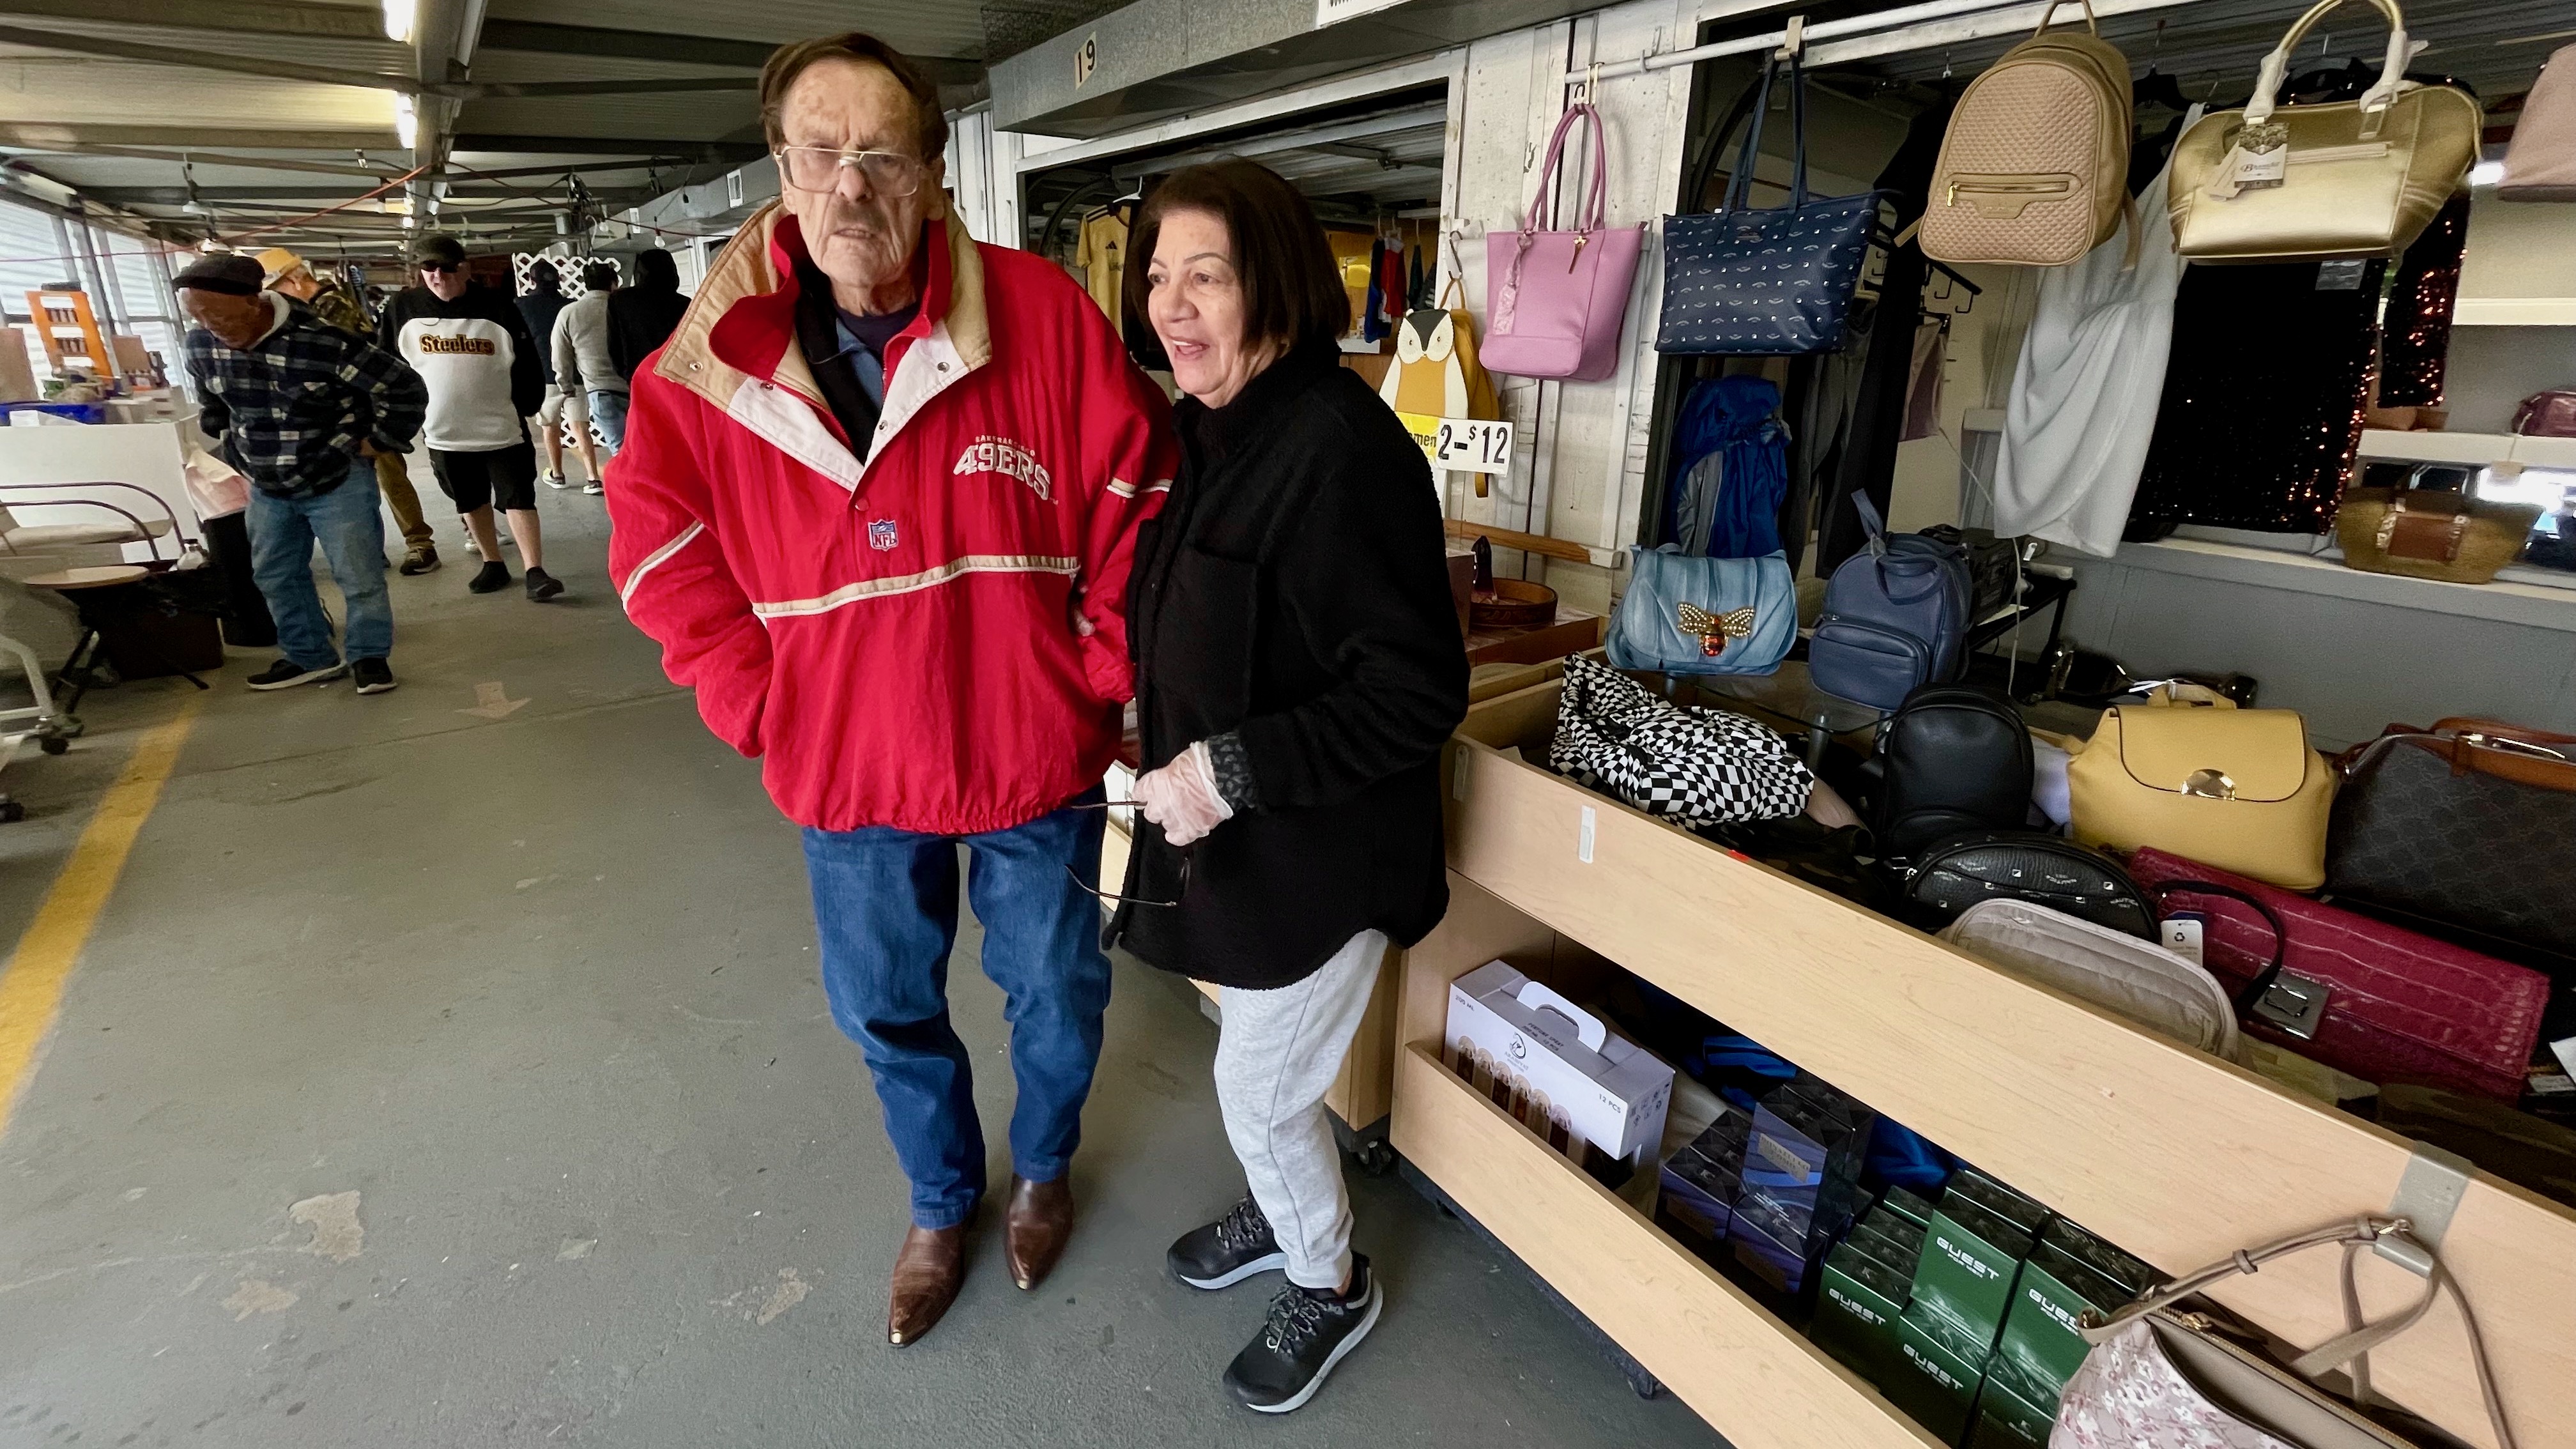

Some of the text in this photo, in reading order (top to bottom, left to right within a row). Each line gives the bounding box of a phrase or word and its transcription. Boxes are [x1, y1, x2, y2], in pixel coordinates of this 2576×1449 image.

[1078, 40, 1095, 83] 19
[420, 334, 495, 356] Steelers
[953, 443, 1051, 501] 49ERS
[875, 532, 896, 548] NFL
[1599, 1093, 1621, 1114] 12 PCS
[1936, 1236, 2000, 1280] GUEST
[1828, 1288, 1886, 1326] GUEST
[2028, 1288, 2078, 1331] GUES
[1903, 1343, 1964, 1390] GUEST
